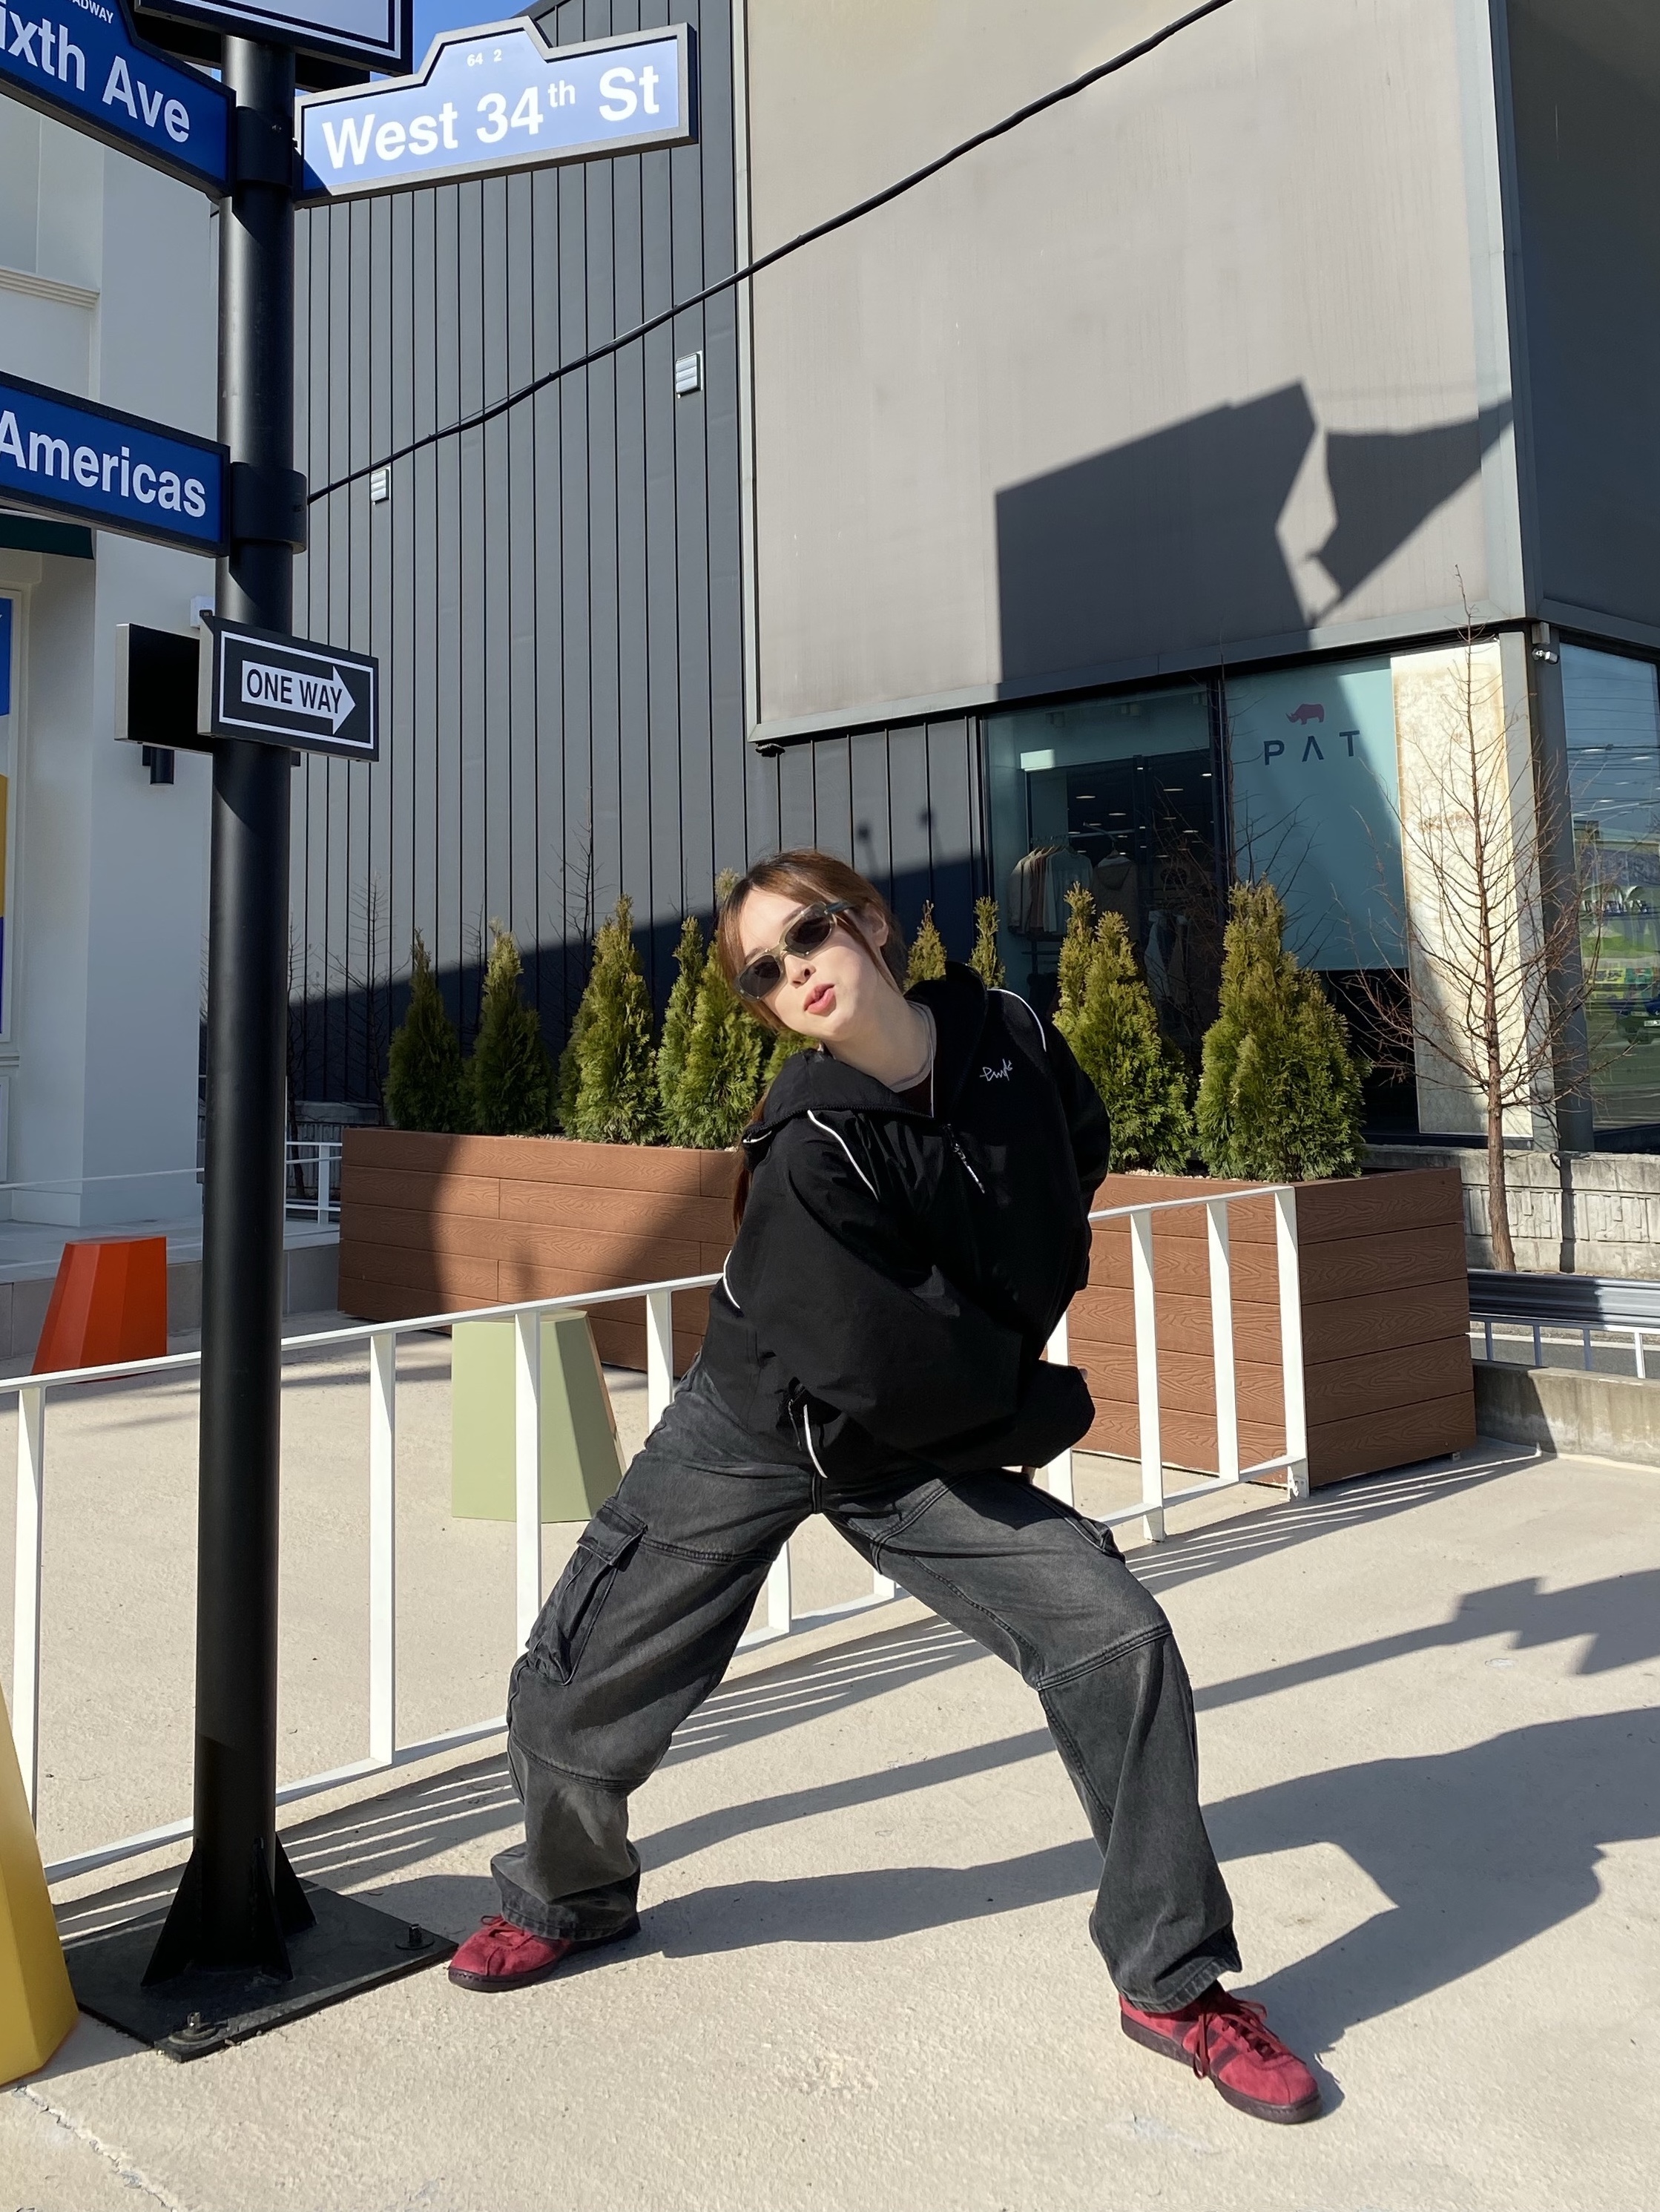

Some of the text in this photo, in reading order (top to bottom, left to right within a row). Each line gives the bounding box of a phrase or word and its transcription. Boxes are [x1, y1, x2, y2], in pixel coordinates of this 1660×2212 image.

[102, 56, 190, 142] Ave
[467, 49, 502, 67] 64 2
[322, 65, 659, 169] West 34th St
[0, 410, 206, 518] Americas
[246, 668, 343, 714] ONE WAY
